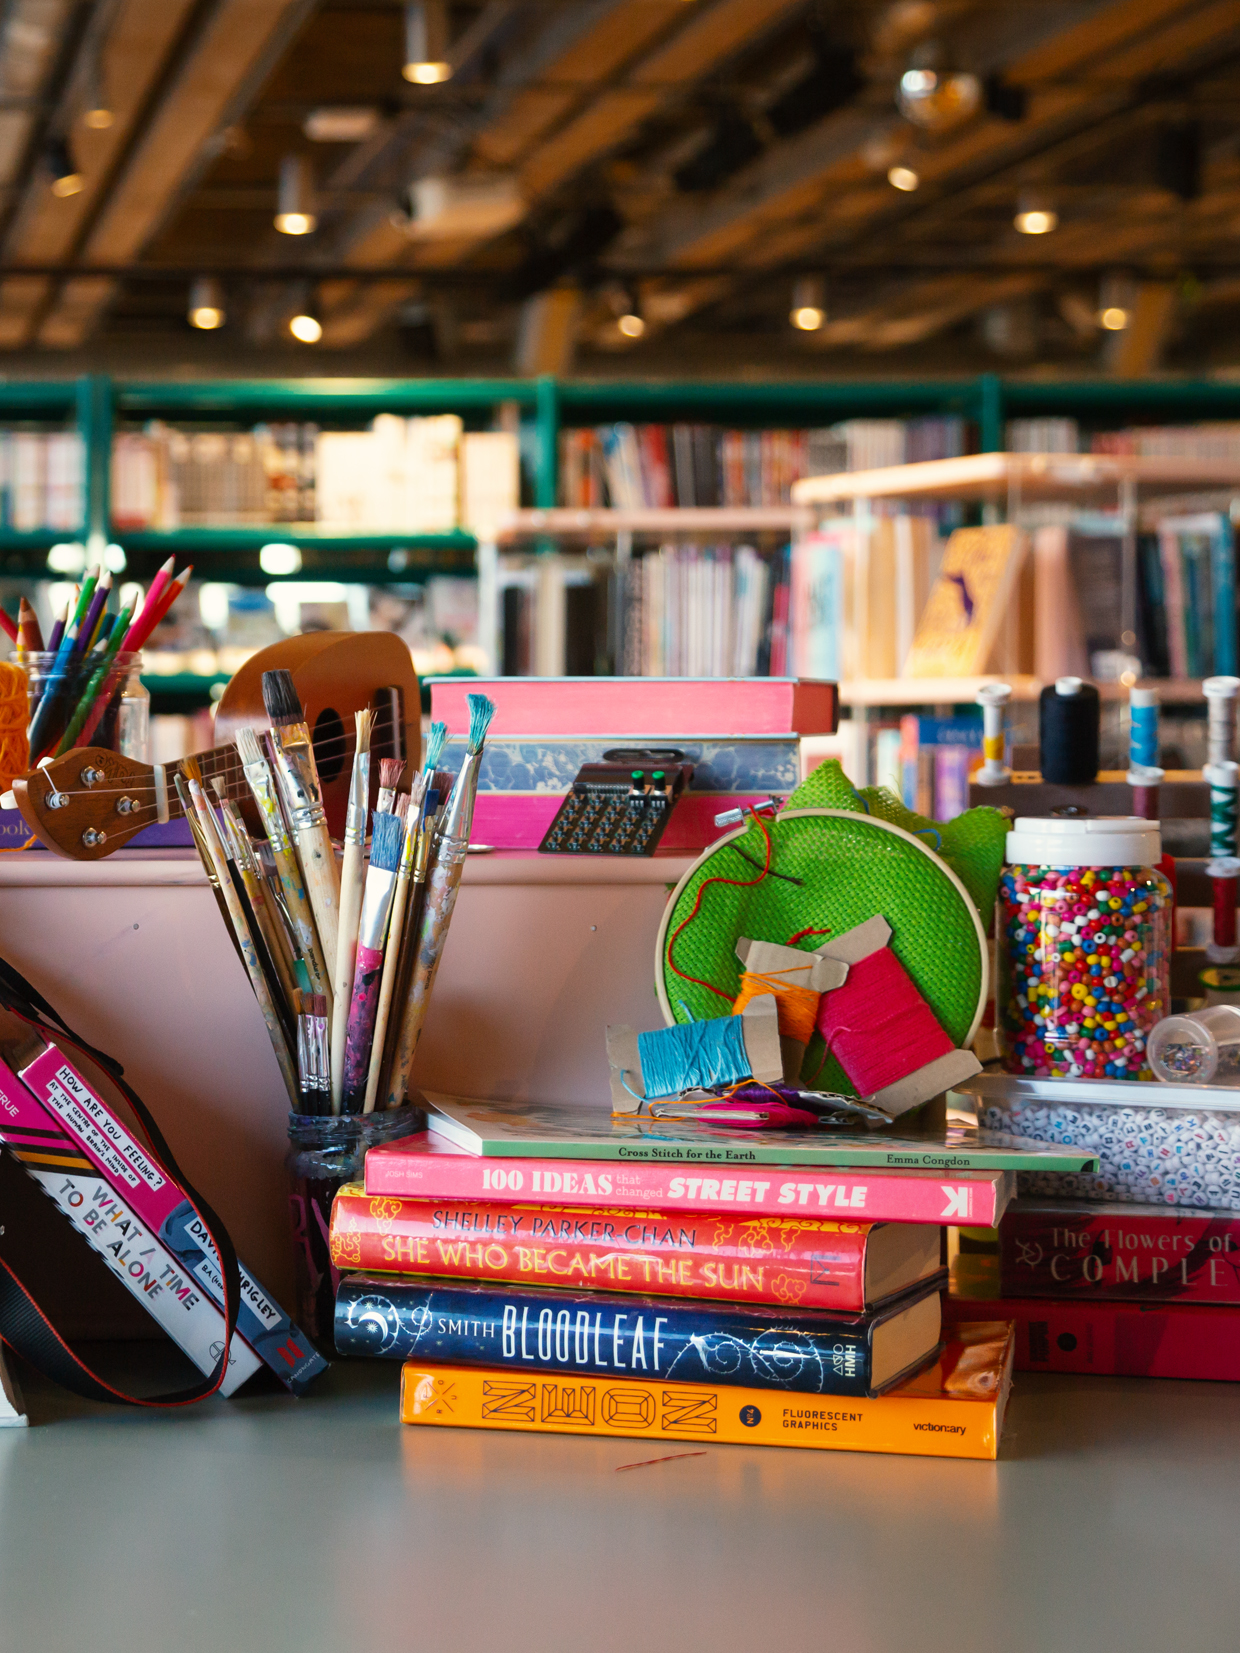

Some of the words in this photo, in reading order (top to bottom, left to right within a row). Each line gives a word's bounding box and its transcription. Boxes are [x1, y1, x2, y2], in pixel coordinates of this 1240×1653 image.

[59, 1068, 83, 1093] HOW
[83, 1097, 104, 1118] ARE
[102, 1119, 122, 1140] YOU
[49, 1081, 59, 1091] AT
[60, 1093, 71, 1106] THE
[72, 1107, 90, 1128] CENTRE
[91, 1129, 99, 1137] OF
[100, 1139, 111, 1151] THE
[112, 1154, 129, 1173] INSIDE
[127, 1174, 137, 1182] OF
[51, 1097, 64, 1109] THE
[66, 1113, 84, 1133] HUMAN
[105, 1157, 119, 1174] MIND
[618, 1146, 649, 1158] Cross
[651, 1147, 683, 1159] Stitch
[686, 1148, 702, 1159] for
[704, 1148, 723, 1160] the
[726, 1149, 756, 1161] Earth
[887, 1154, 919, 1165] Emma
[921, 1154, 970, 1168] Congdon
[385, 1170, 404, 1178] JOSH
[405, 1170, 423, 1179] SIMS
[482, 1168, 523, 1190] 100
[532, 1170, 613, 1196] IDEAS
[615, 1173, 641, 1185] that
[615, 1186, 663, 1199] changed
[667, 1177, 770, 1203] STREET
[777, 1182, 867, 1208] STYLE
[59, 1178, 84, 1207] TO
[82, 1208, 109, 1237] BE
[106, 1240, 165, 1301] ALONE
[190, 1220, 220, 1261] DAV
[432, 1210, 524, 1236] SHELLEY
[532, 1217, 697, 1249] PARKER-CHAN
[1053, 1228, 1091, 1247] The
[1104, 1229, 1195, 1250] Flowers
[1209, 1233, 1233, 1252] of
[92, 1185, 143, 1242] WHAT
[139, 1247, 156, 1265] A
[159, 1263, 200, 1311] TIME
[383, 1236, 431, 1264] SHE
[437, 1240, 508, 1270] WHO
[519, 1247, 632, 1281] BECAME
[640, 1257, 694, 1286] THE
[704, 1262, 764, 1292] SUN
[1050, 1254, 1228, 1287] COMPLE
[438, 1318, 495, 1338] SMITH
[502, 1305, 668, 1371] BLOODLEAF
[844, 1344, 857, 1377] HMH
[481, 1380, 717, 1433] NEON
[782, 1409, 863, 1422] FLUORESCENT
[782, 1419, 838, 1431] GRAPHICS
[913, 1422, 967, 1436] viction:ary
